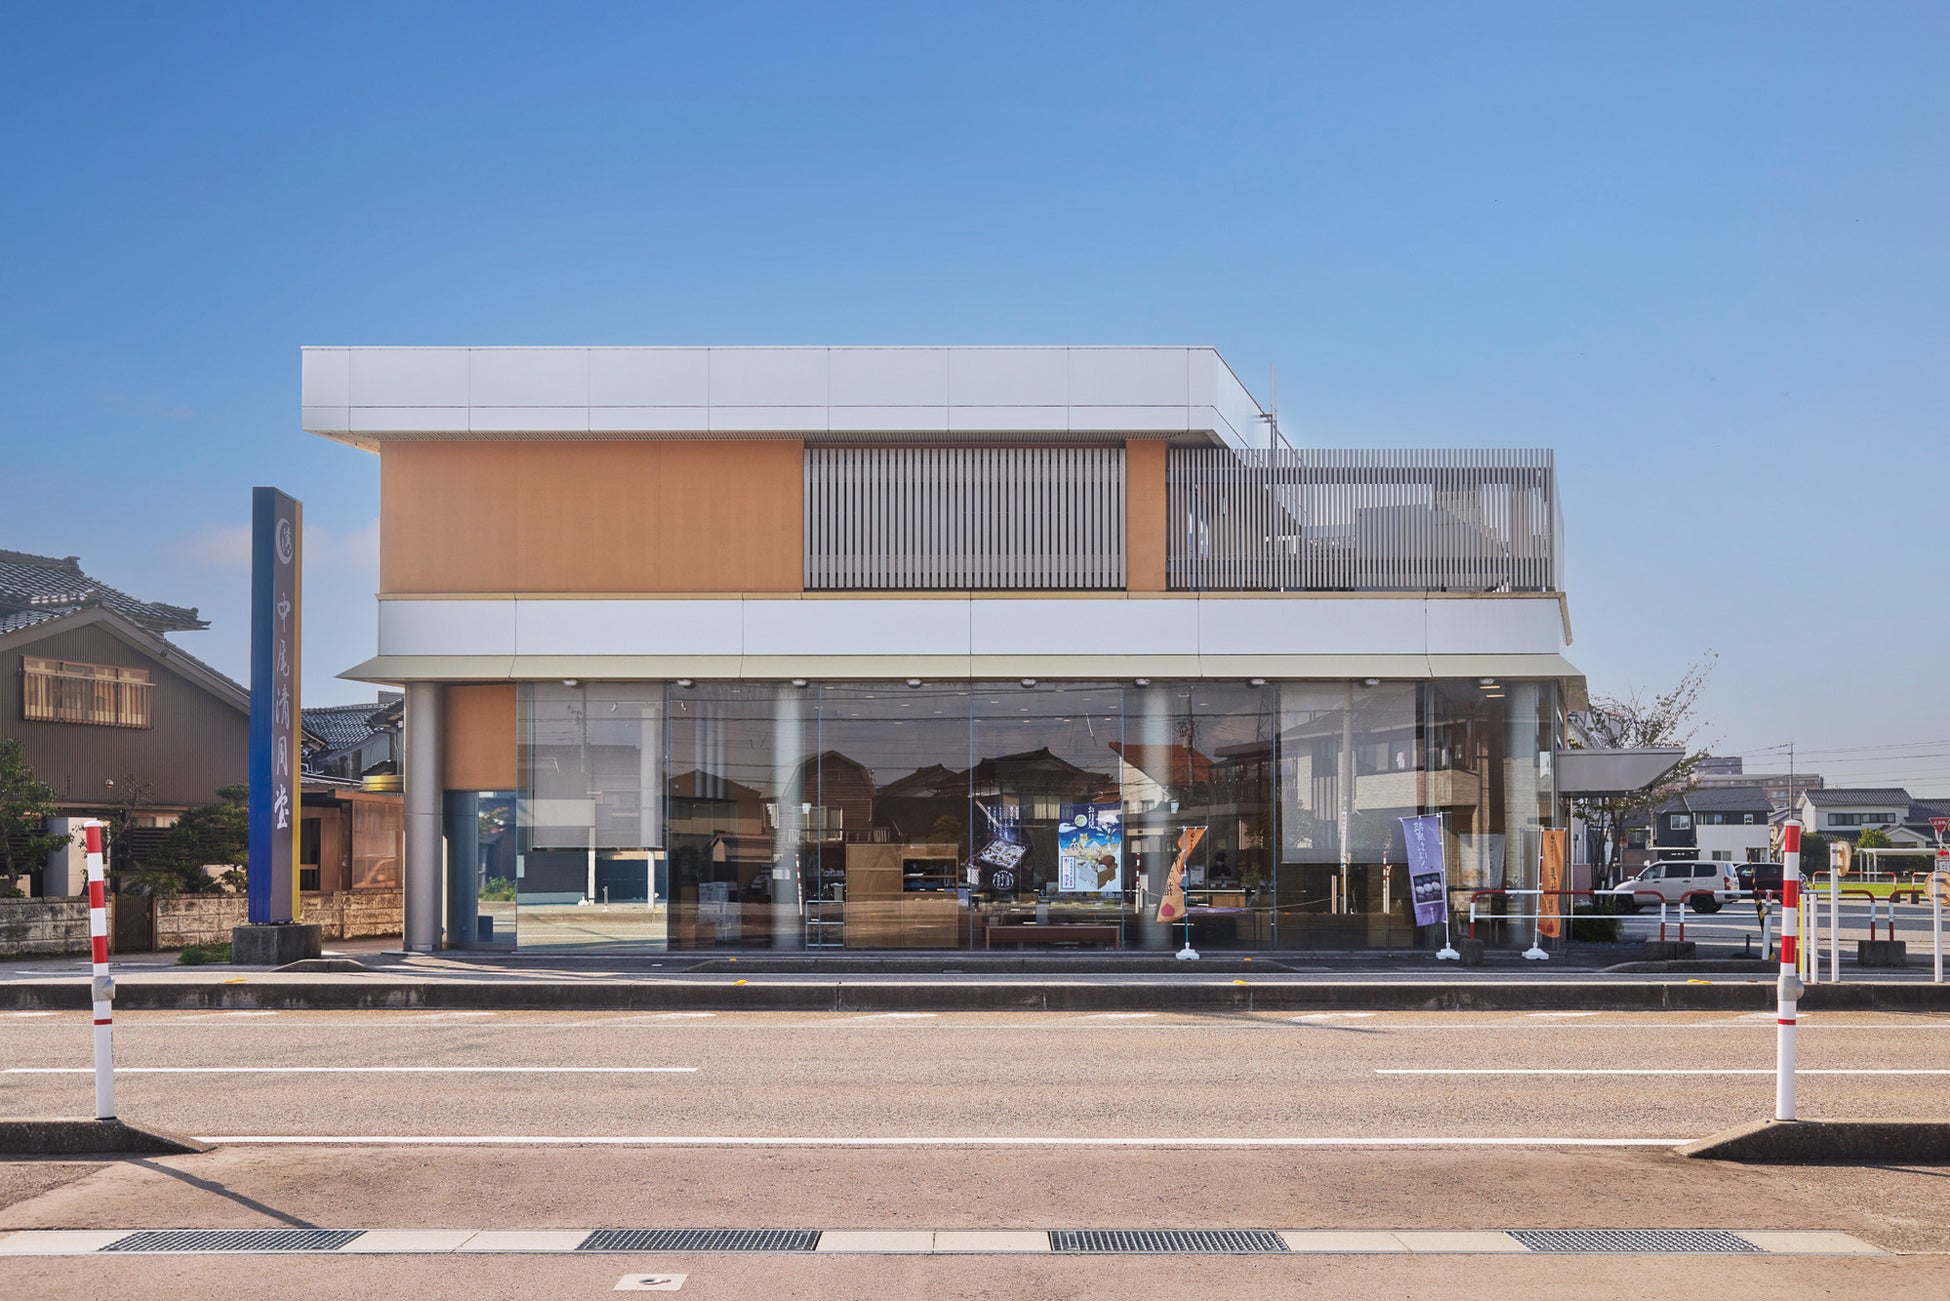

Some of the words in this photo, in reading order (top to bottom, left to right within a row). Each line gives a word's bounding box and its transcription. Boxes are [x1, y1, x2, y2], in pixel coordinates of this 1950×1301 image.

[274, 591, 291, 830] 中尾清月堂
[1087, 805, 1096, 829] お月見
